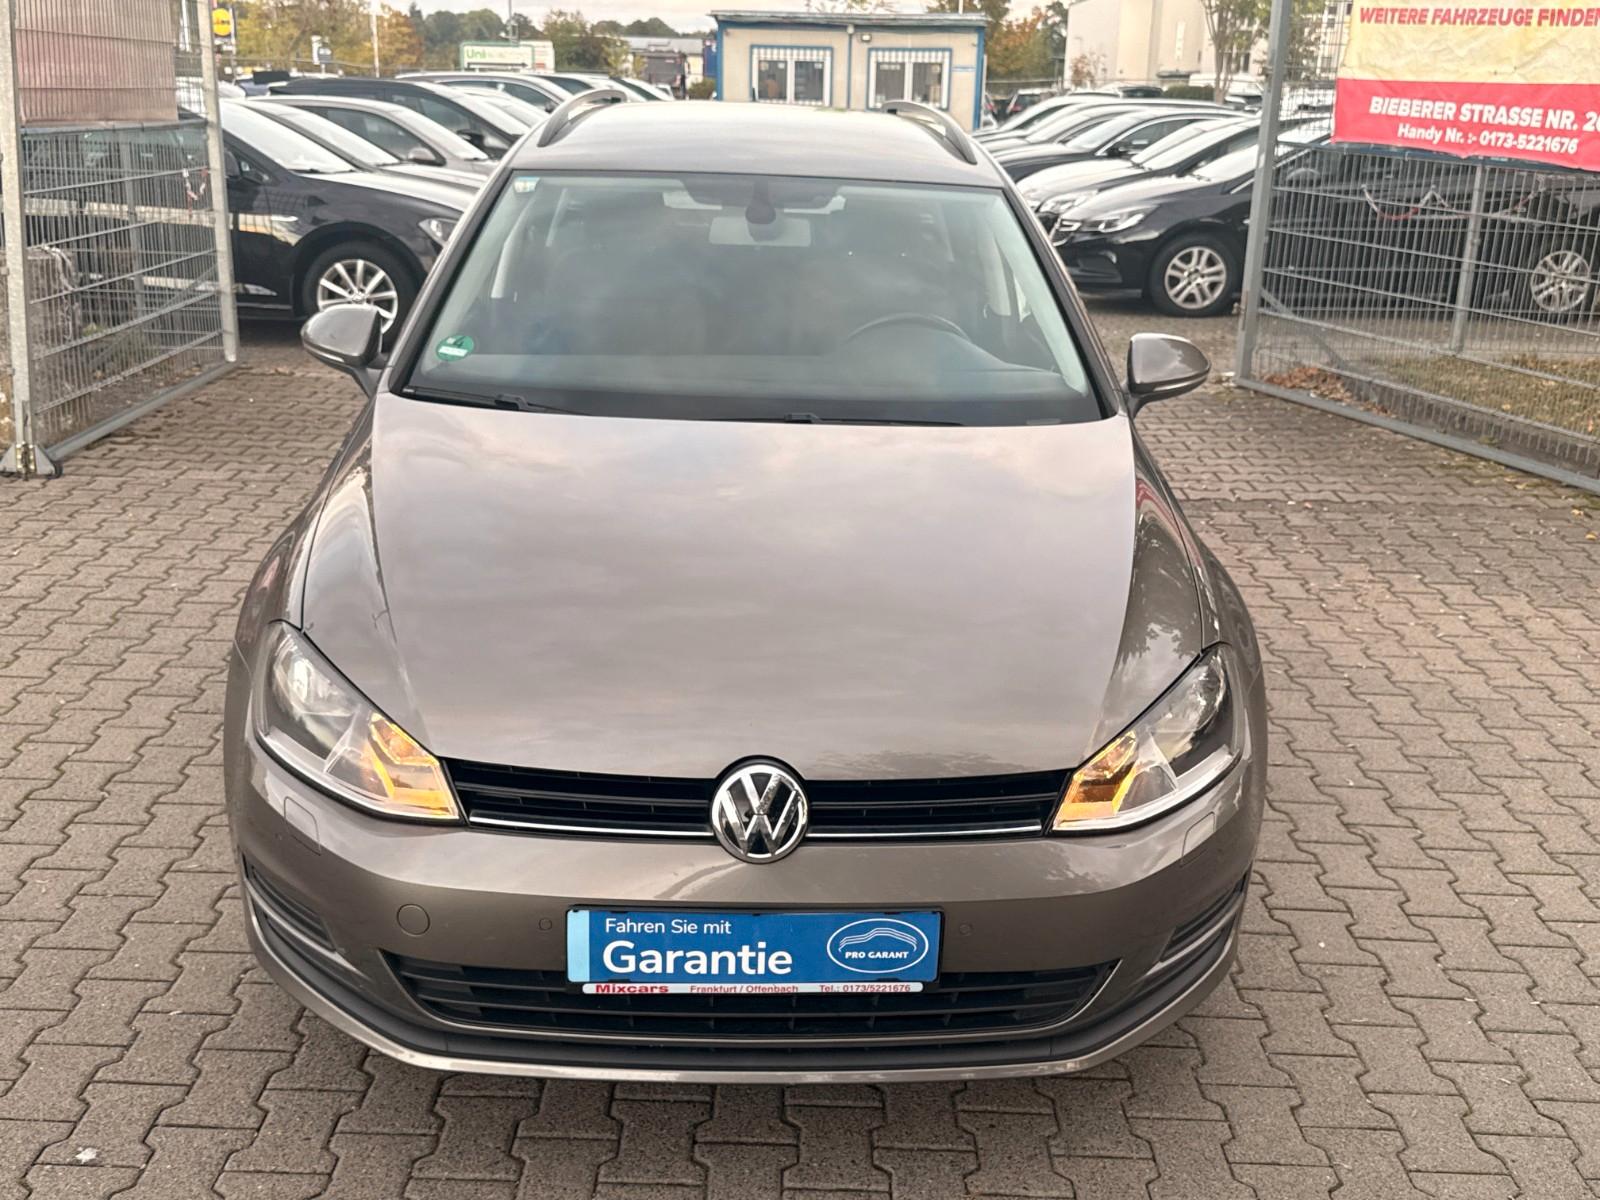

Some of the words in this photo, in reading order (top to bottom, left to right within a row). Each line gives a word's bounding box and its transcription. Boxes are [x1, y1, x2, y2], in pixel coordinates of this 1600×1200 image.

[1360, 7, 1429, 25] WEITERE
[1431, 8, 1534, 26] FAHRZEUGE
[1369, 96, 1457, 121] BIEBERER
[1459, 103, 1544, 128] STRASSE
[1545, 109, 1579, 131] NR.
[1397, 123, 1443, 145] Handy
[1444, 127, 1465, 144] Nr.
[1480, 130, 1579, 154] 0173-5221676
[605, 918, 666, 934] Fahren
[671, 919, 698, 934] Sie
[703, 920, 732, 935] mit
[602, 940, 793, 975] Garantie
[845, 951, 865, 959] PRO
[867, 951, 909, 959] GARANT
[595, 984, 669, 993] Mixcars
[690, 985, 737, 993] Frankfurt
[745, 985, 799, 993] Offenbach
[819, 984, 840, 992] Tel.:
[842, 984, 911, 992] 0173/5221676
